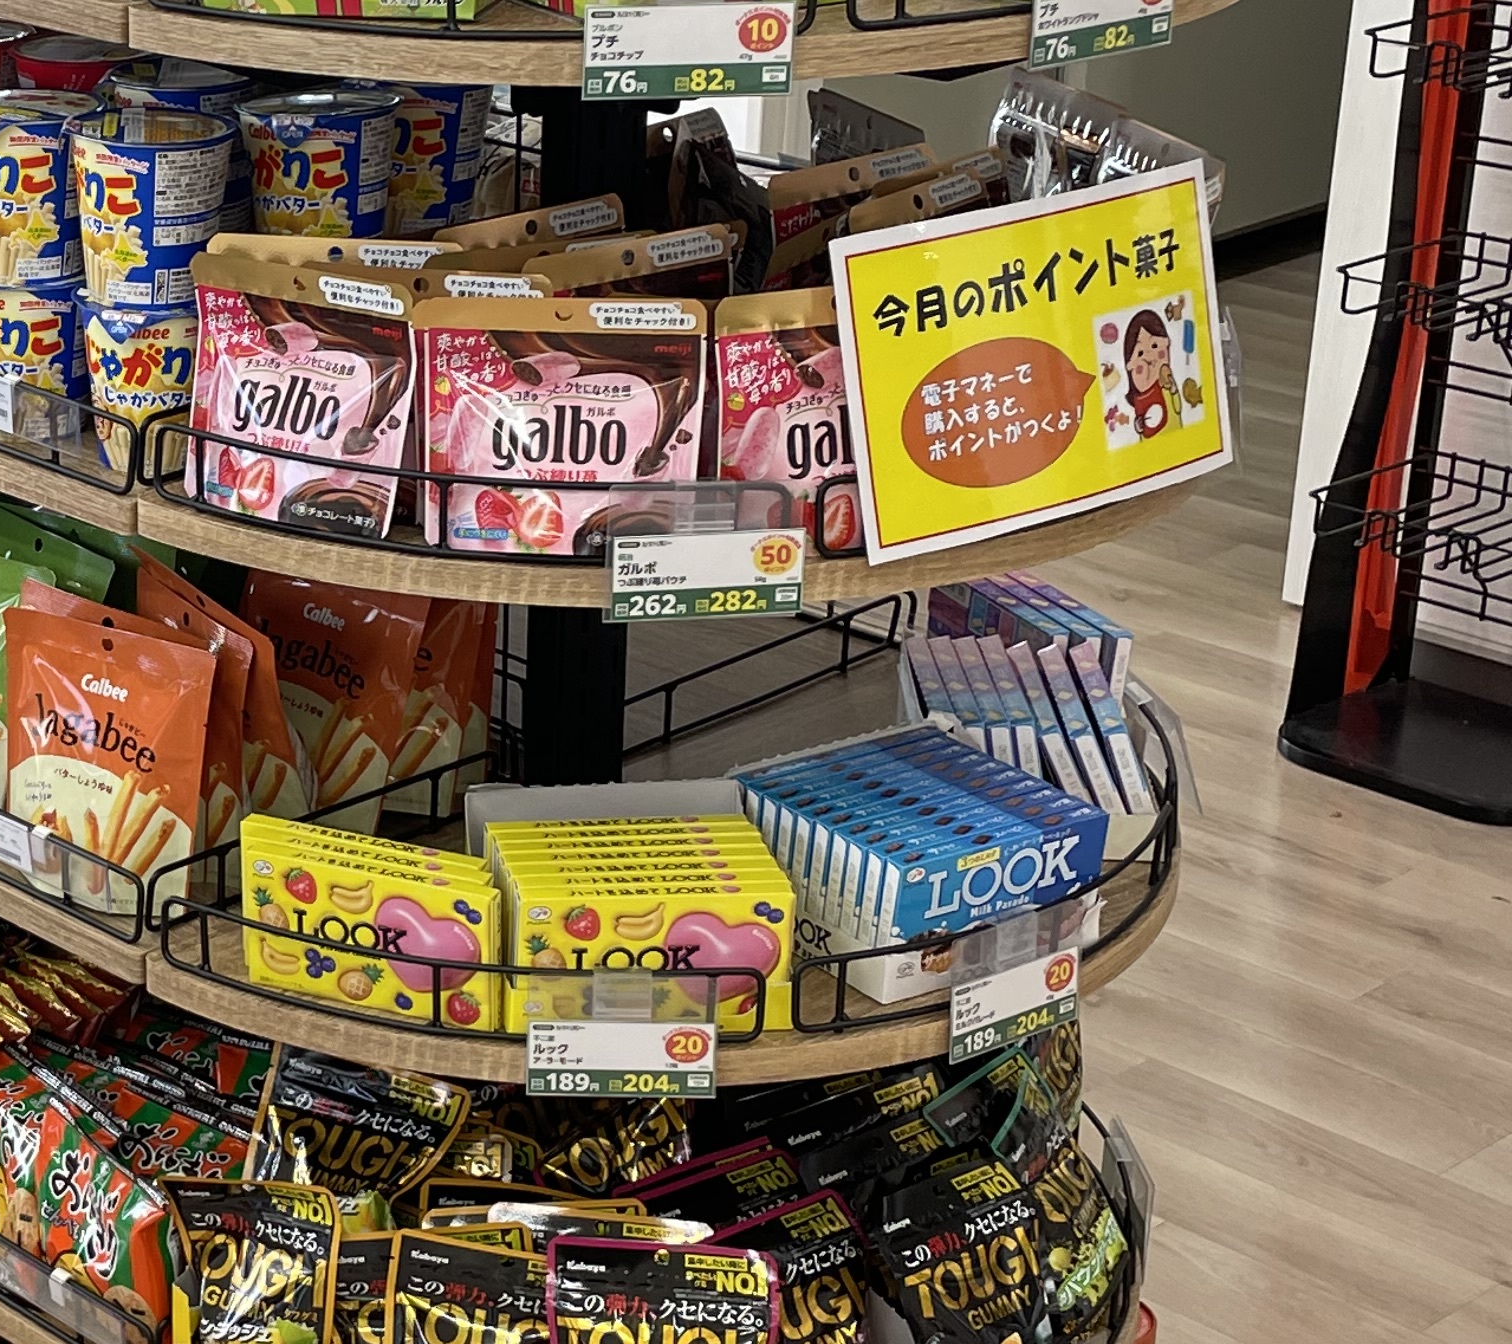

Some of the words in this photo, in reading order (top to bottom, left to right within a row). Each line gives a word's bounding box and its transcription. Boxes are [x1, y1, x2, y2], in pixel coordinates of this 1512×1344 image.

[591, 35, 619, 48] プチ
[747, 17, 779, 42] 10
[590, 50, 644, 61] チョコチップ
[872, 228, 1180, 338] 今月のポイント菓子
[595, 304, 676, 315] チョコチョコ食べやすい
[372, 327, 403, 341] meiji
[654, 342, 692, 355] meiji
[920, 363, 1034, 407] 電子マネーで
[232, 375, 341, 441] galbo
[586, 406, 616, 417] ガルボ
[924, 395, 1025, 435] 購入すると、
[492, 405, 627, 469] galbo
[787, 404, 855, 479] gal
[928, 406, 1084, 462] ポイントがつくよ!
[618, 561, 658, 576] ガルボ
[760, 544, 792, 566] 50
[303, 601, 347, 633] Calbee
[80, 673, 129, 702] Calbee
[34, 694, 157, 774] Jagabee
[924, 834, 1081, 919] LOOK
[290, 908, 408, 954] LOOK
[1049, 961, 1071, 985] 20
[533, 1043, 569, 1055] ルック
[672, 1035, 703, 1054] 20
[967, 1288, 1031, 1331] GUMMY
